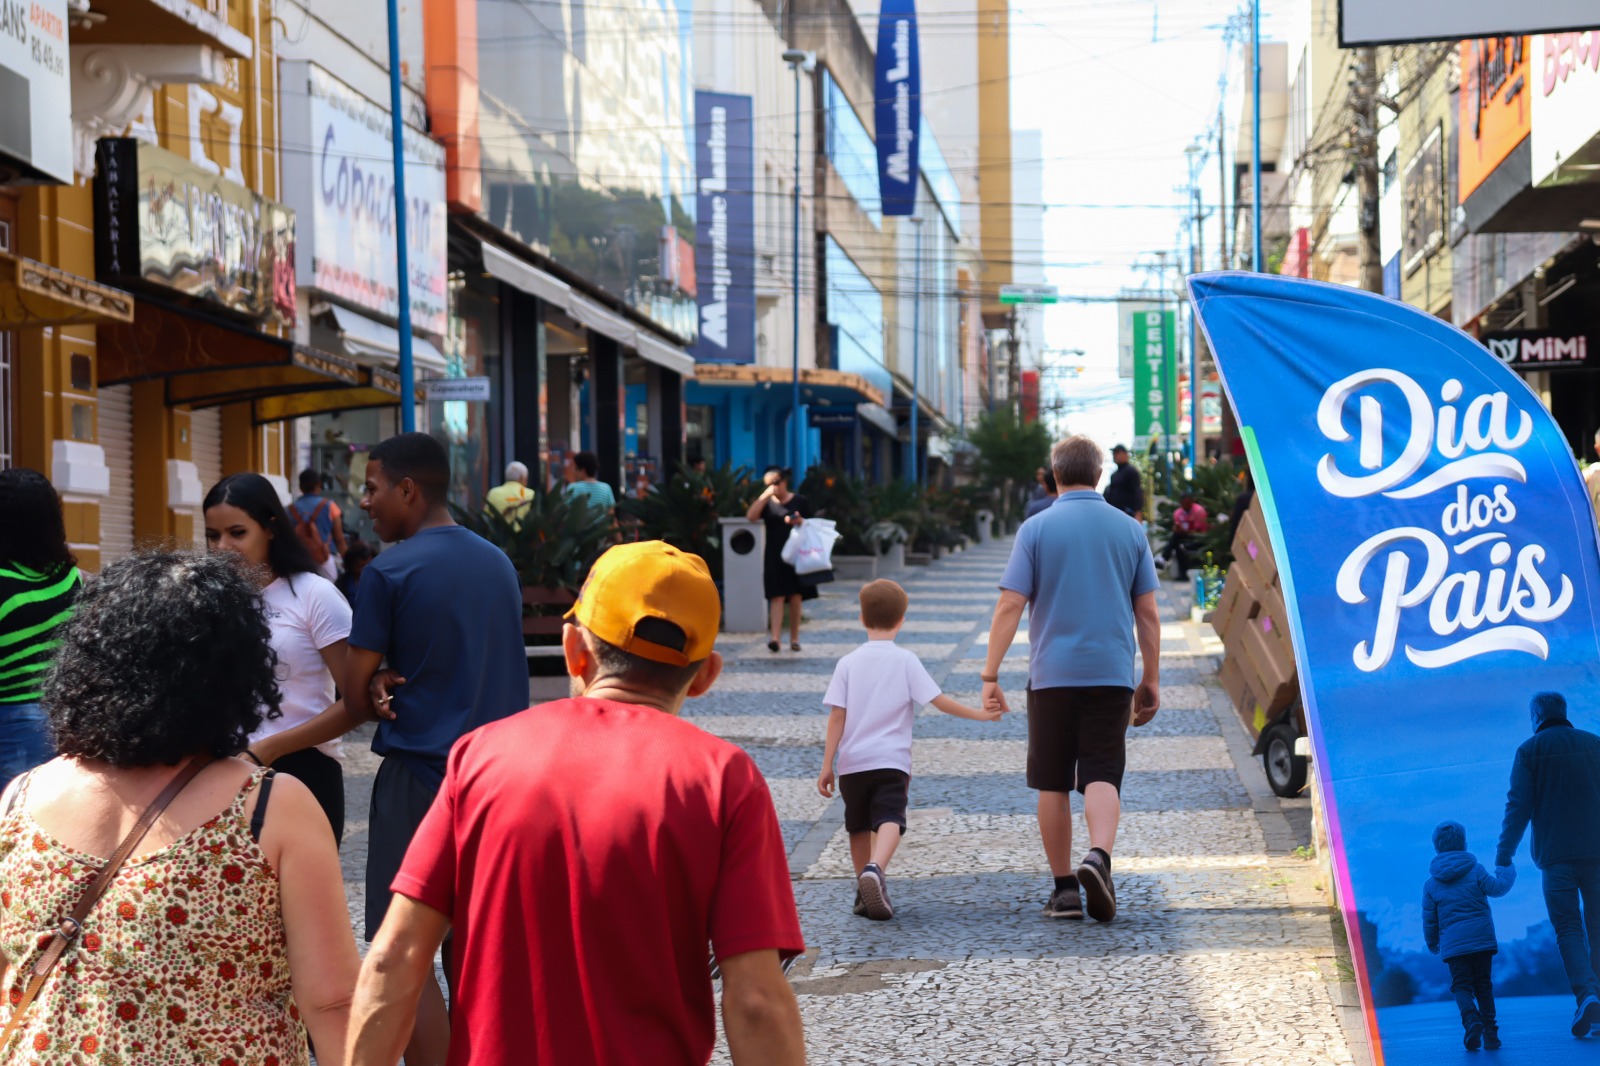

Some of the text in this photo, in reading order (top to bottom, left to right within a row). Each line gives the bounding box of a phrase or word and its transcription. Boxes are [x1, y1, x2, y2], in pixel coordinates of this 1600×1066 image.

[0, 0, 26, 45] ANS
[886, 20, 913, 184] Magazine Luiza
[107, 140, 121, 273] TABACARIA
[700, 106, 732, 348] Magazine Luiza
[1145, 312, 1164, 435] DENTISTA
[1521, 335, 1587, 362] MiMi
[1317, 368, 1533, 498] Dia
[1441, 484, 1517, 536] dos
[1336, 526, 1574, 672] Pais
